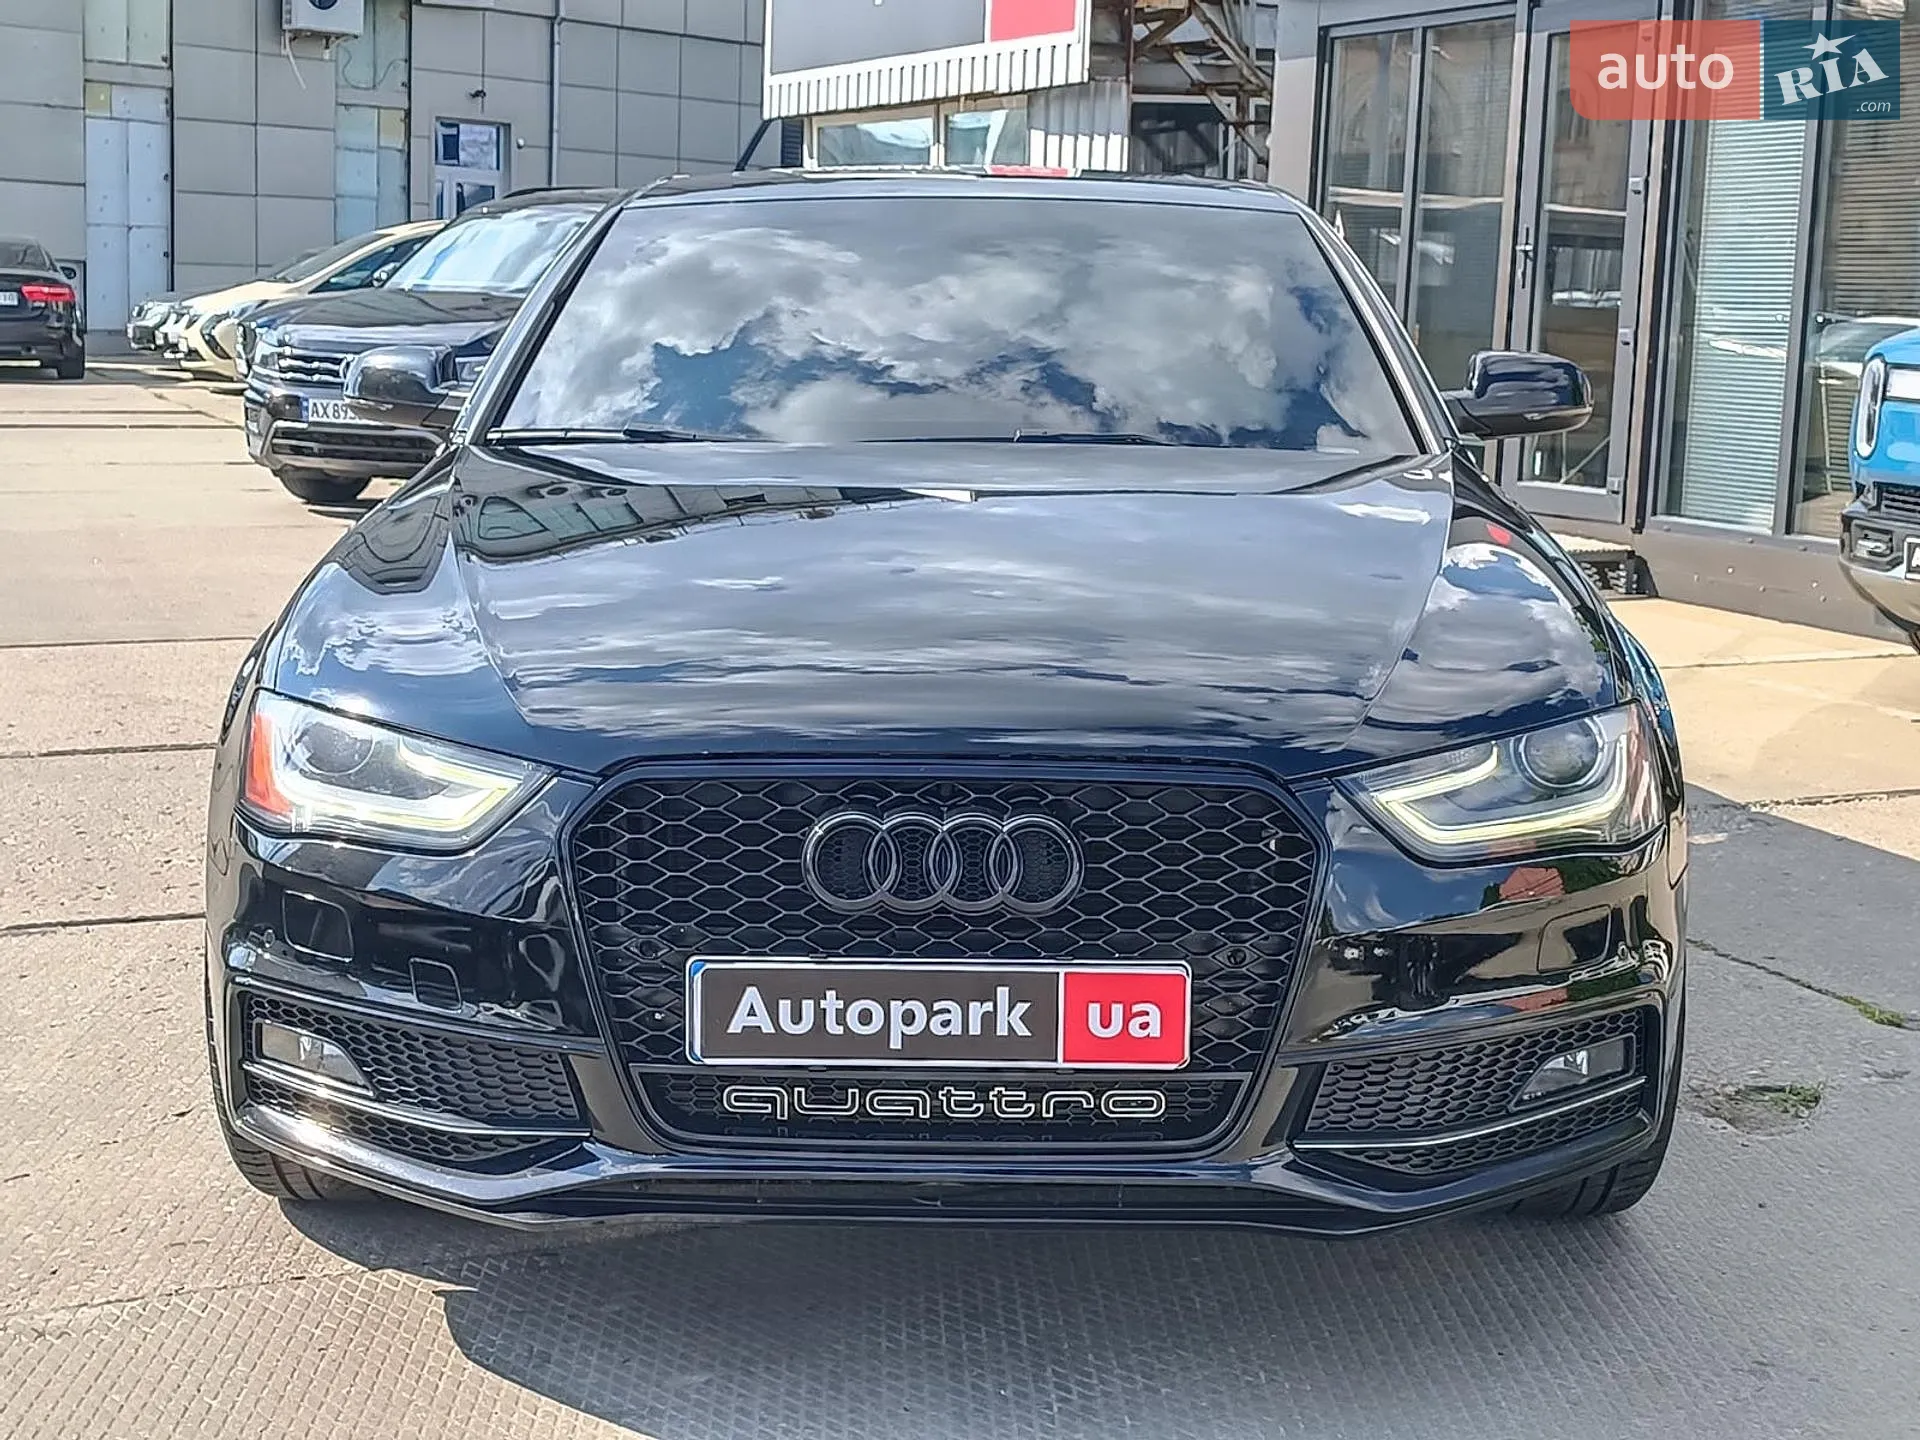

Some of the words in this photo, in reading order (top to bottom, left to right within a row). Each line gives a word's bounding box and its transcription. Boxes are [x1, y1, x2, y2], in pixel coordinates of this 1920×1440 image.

[311, 402, 329, 418] AX
[727, 986, 1032, 1049] Autopark
[1087, 1002, 1162, 1038] ua
[723, 1086, 1166, 1120] quattro
